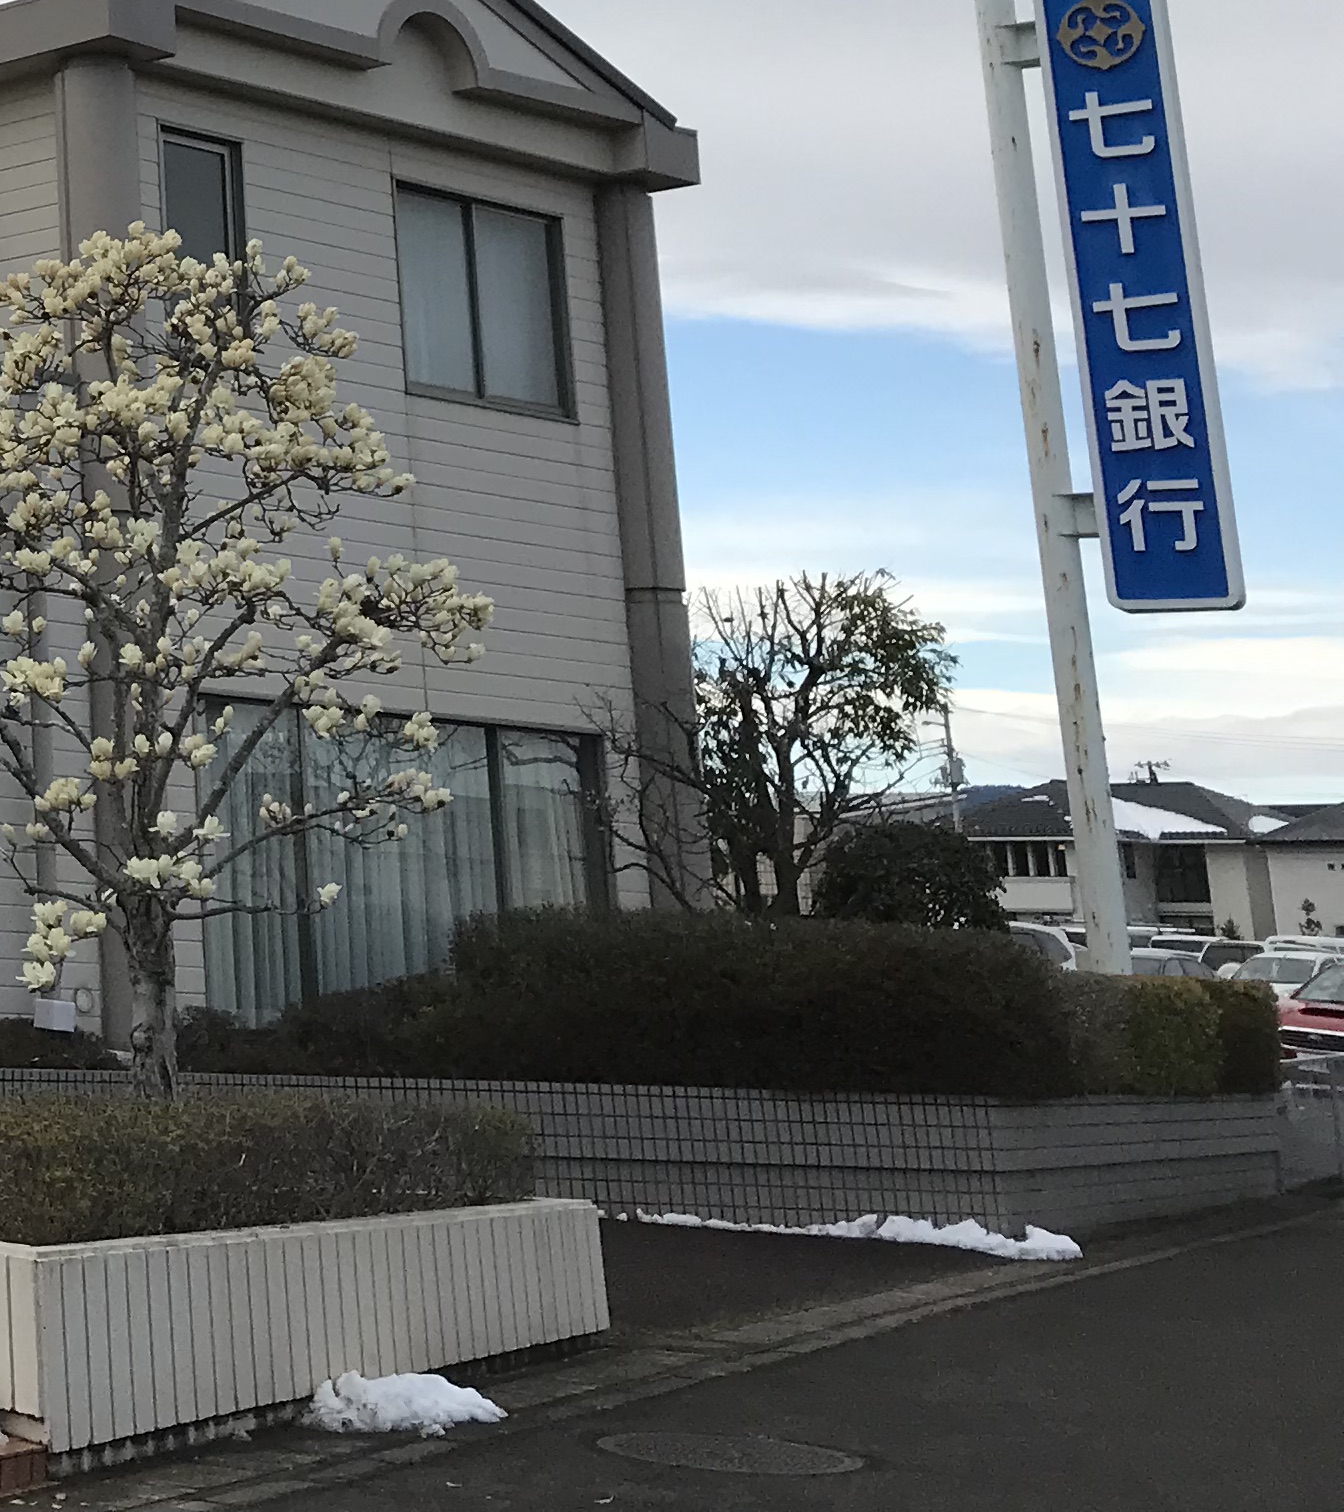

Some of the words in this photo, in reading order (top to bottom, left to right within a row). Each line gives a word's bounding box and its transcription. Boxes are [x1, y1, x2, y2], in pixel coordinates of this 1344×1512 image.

[1068, 91, 1204, 552] 七十七銀行
